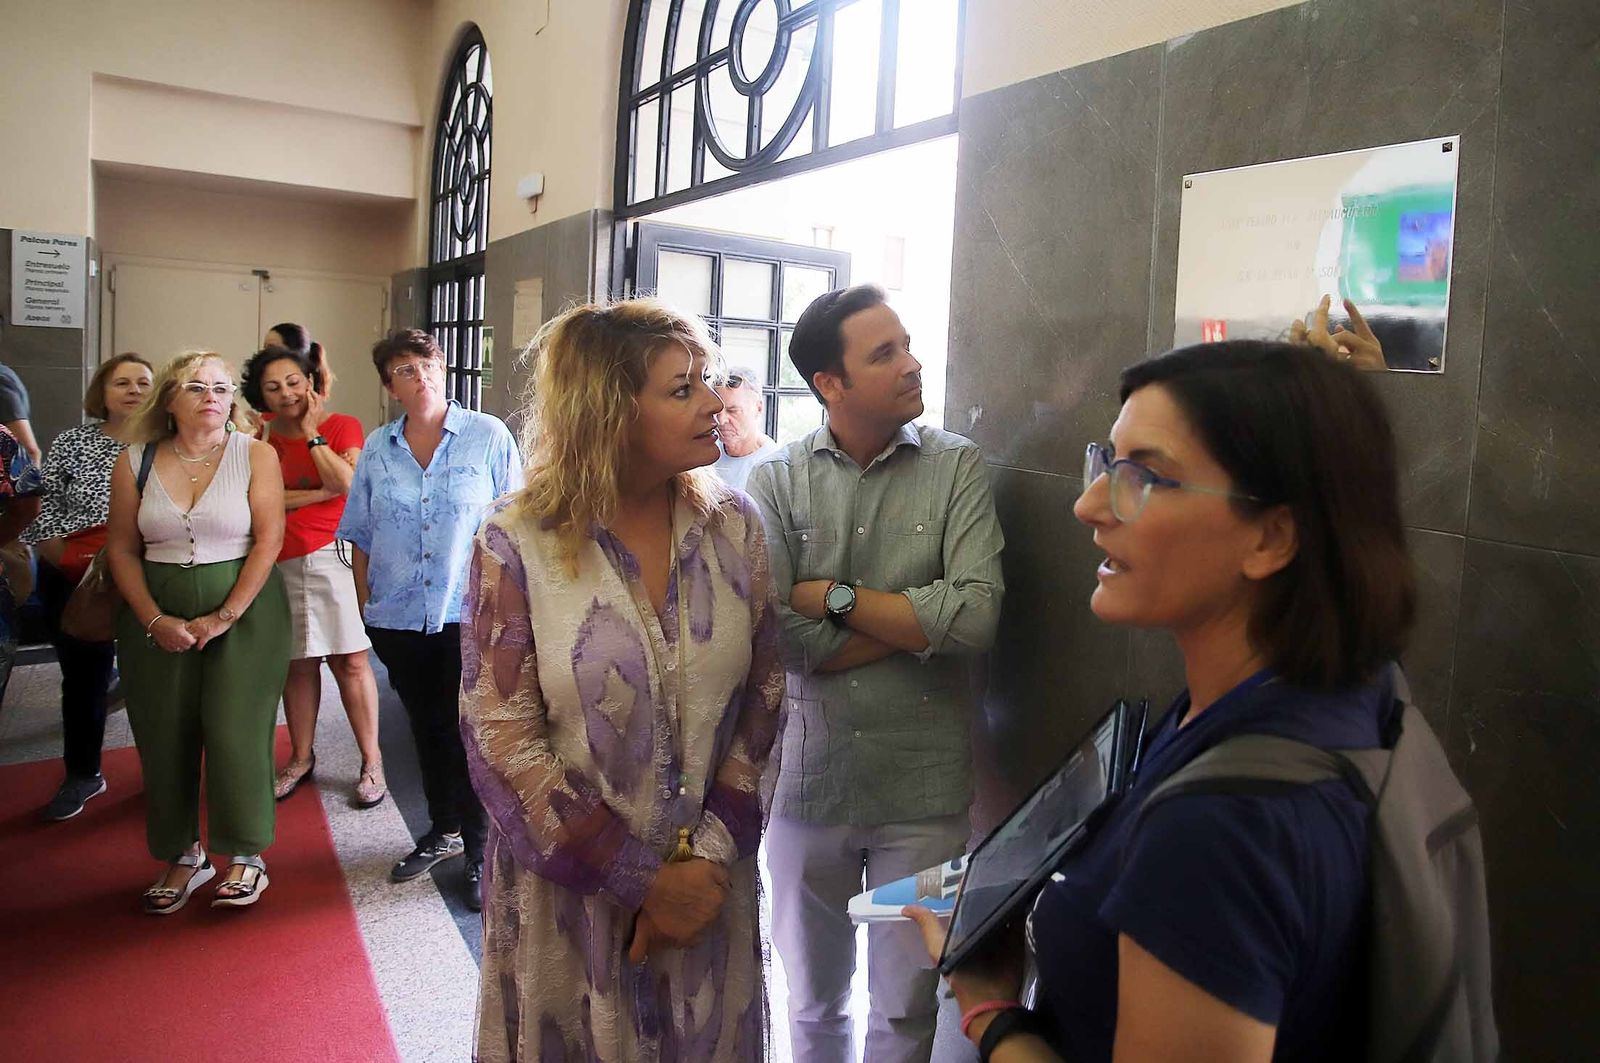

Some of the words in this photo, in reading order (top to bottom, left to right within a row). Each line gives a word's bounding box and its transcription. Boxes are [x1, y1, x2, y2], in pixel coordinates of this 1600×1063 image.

[20, 235, 50, 244] Palcos
[52, 239, 78, 247] Pares
[25, 279, 65, 287] Principal
